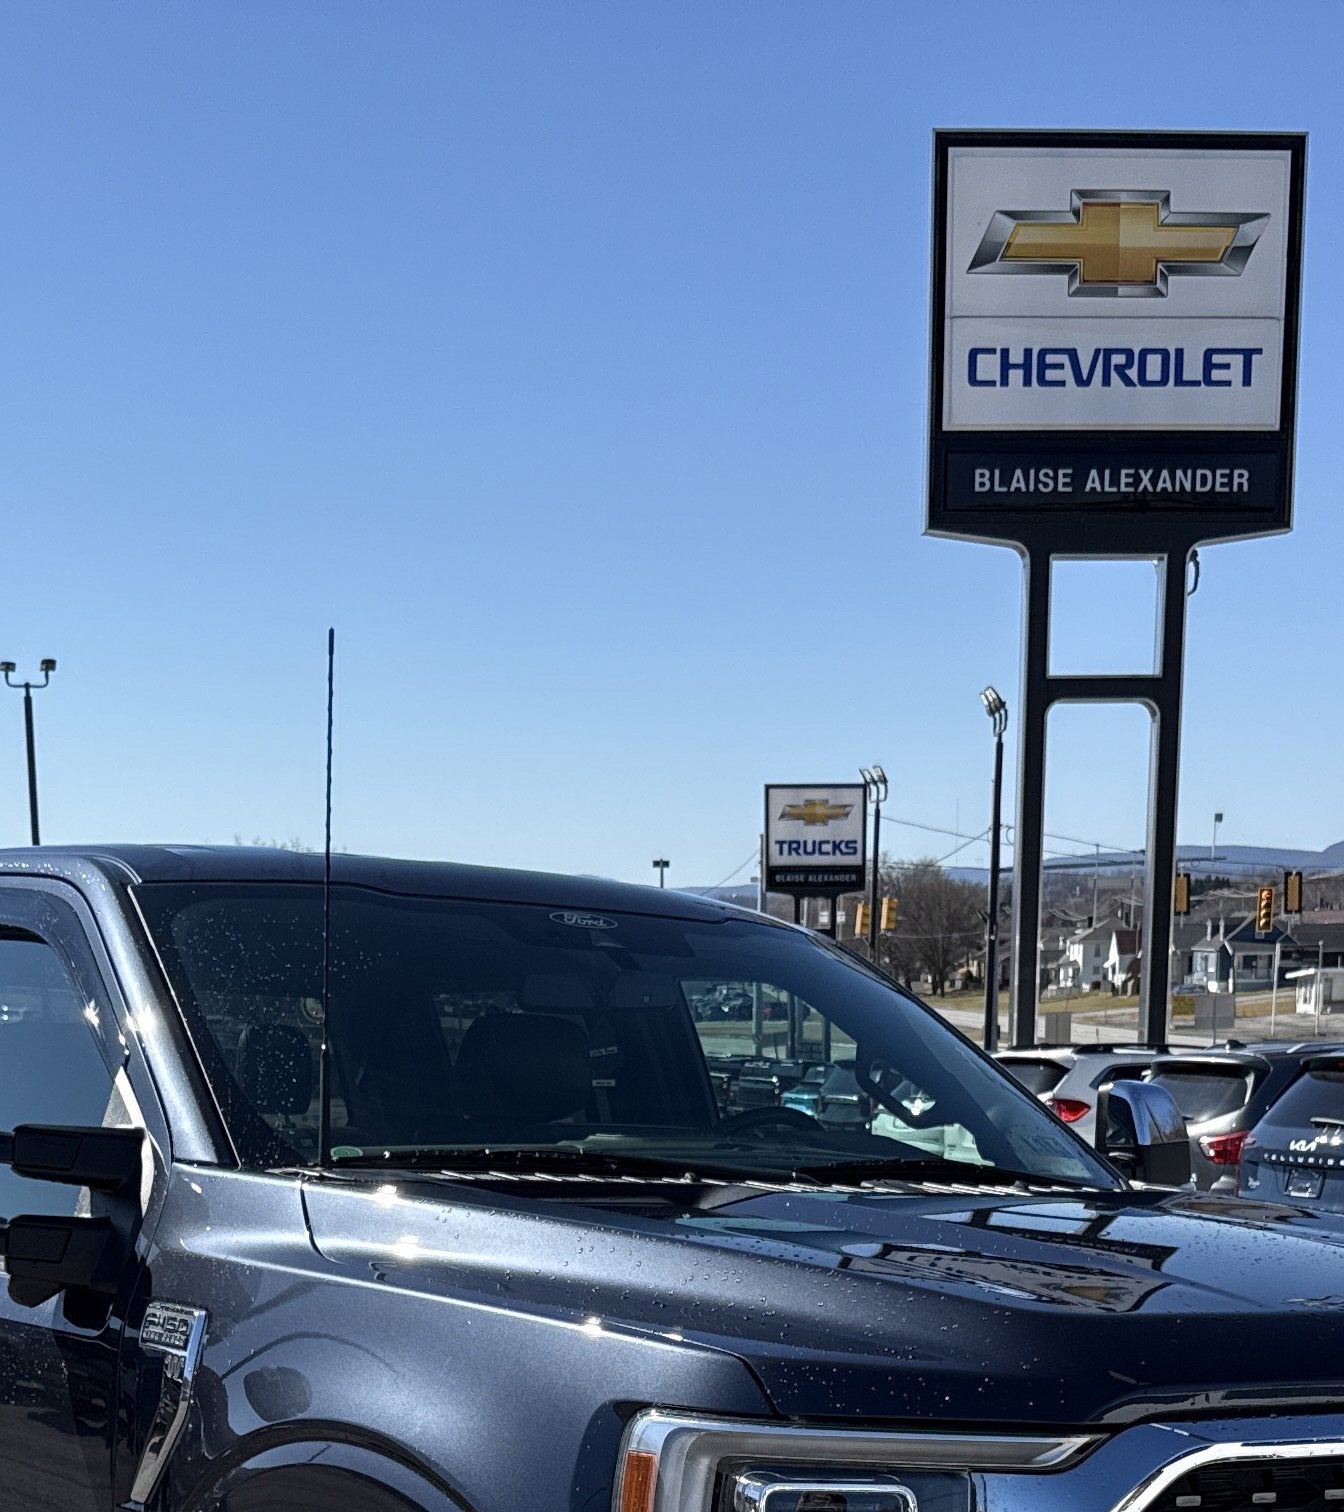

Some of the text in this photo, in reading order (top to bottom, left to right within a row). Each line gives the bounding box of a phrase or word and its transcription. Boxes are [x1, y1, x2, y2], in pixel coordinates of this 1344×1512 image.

[967, 347, 1263, 388] CHEVROLET
[974, 468, 1250, 493] BLAISE ALEXANDER
[774, 839, 858, 856] TRUCKS
[775, 873, 857, 882] BLAISE ALEXANDER
